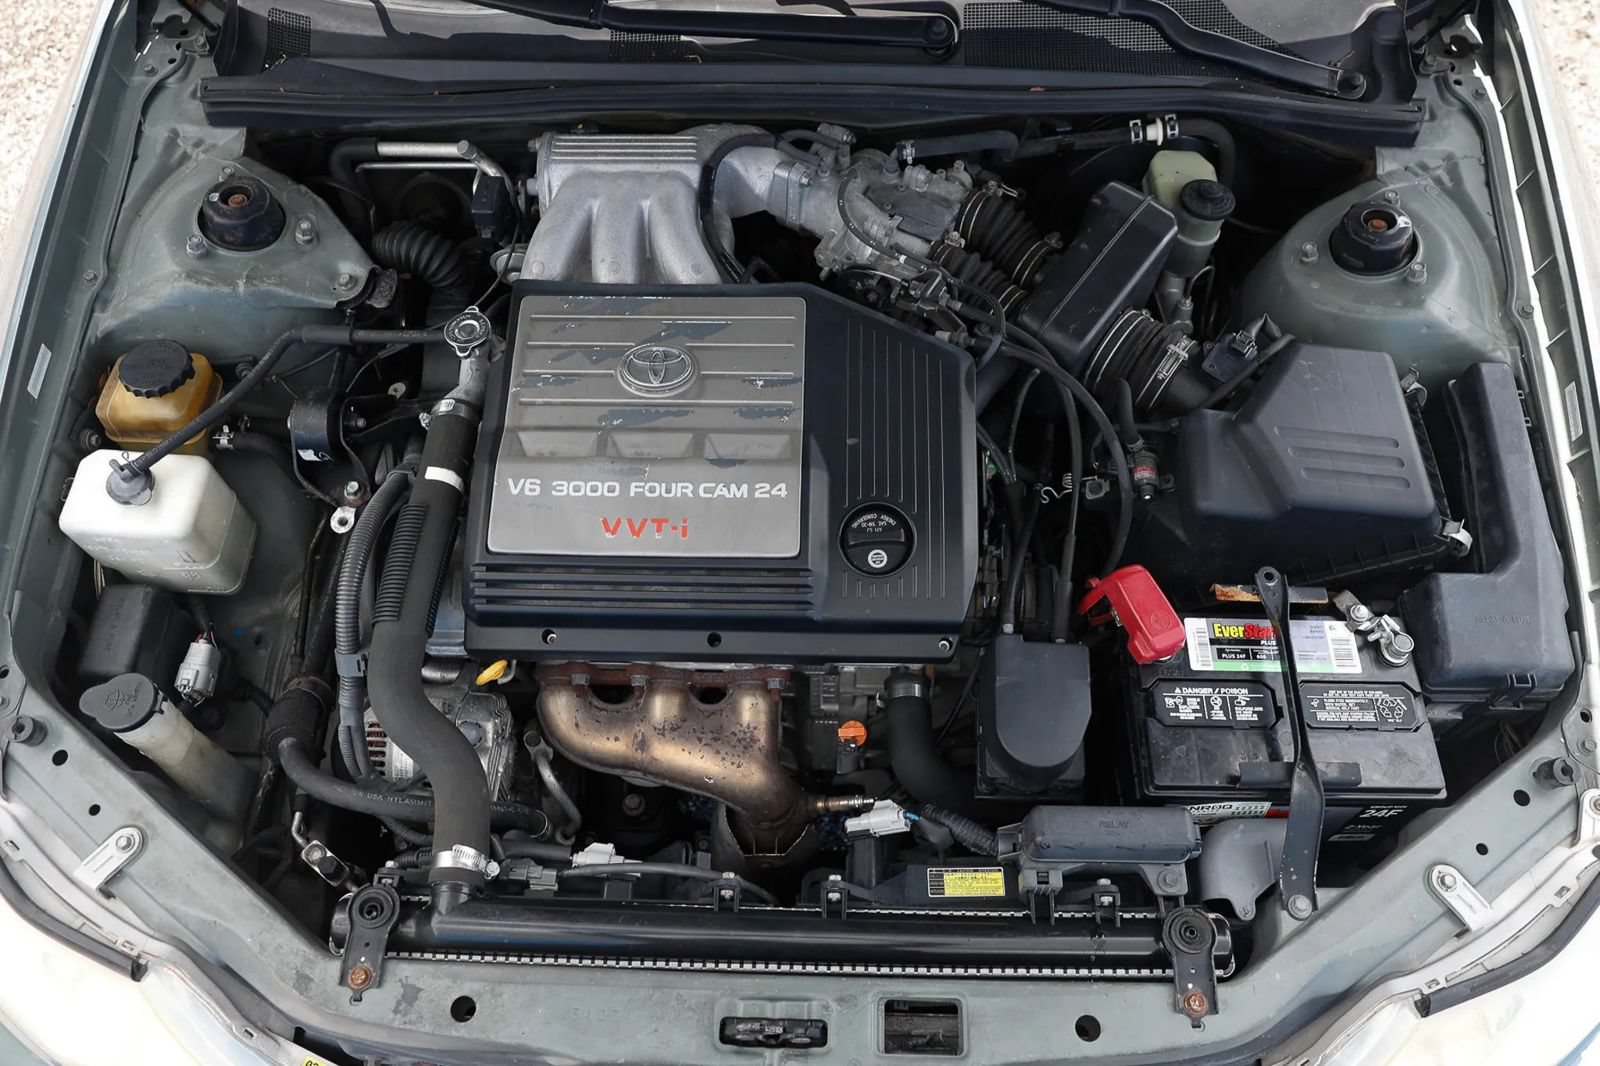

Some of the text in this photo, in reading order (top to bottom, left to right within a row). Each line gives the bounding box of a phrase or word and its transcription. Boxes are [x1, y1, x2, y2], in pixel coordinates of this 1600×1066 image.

[508, 478, 787, 498] V6 3000 FOUR CAM 24
[880, 514, 896, 526] ENERGY
[601, 517, 689, 540] VVT-i
[1213, 623, 1277, 639] EverStar
[1220, 687, 1249, 695] POISON
[1359, 809, 1404, 818] 24F
